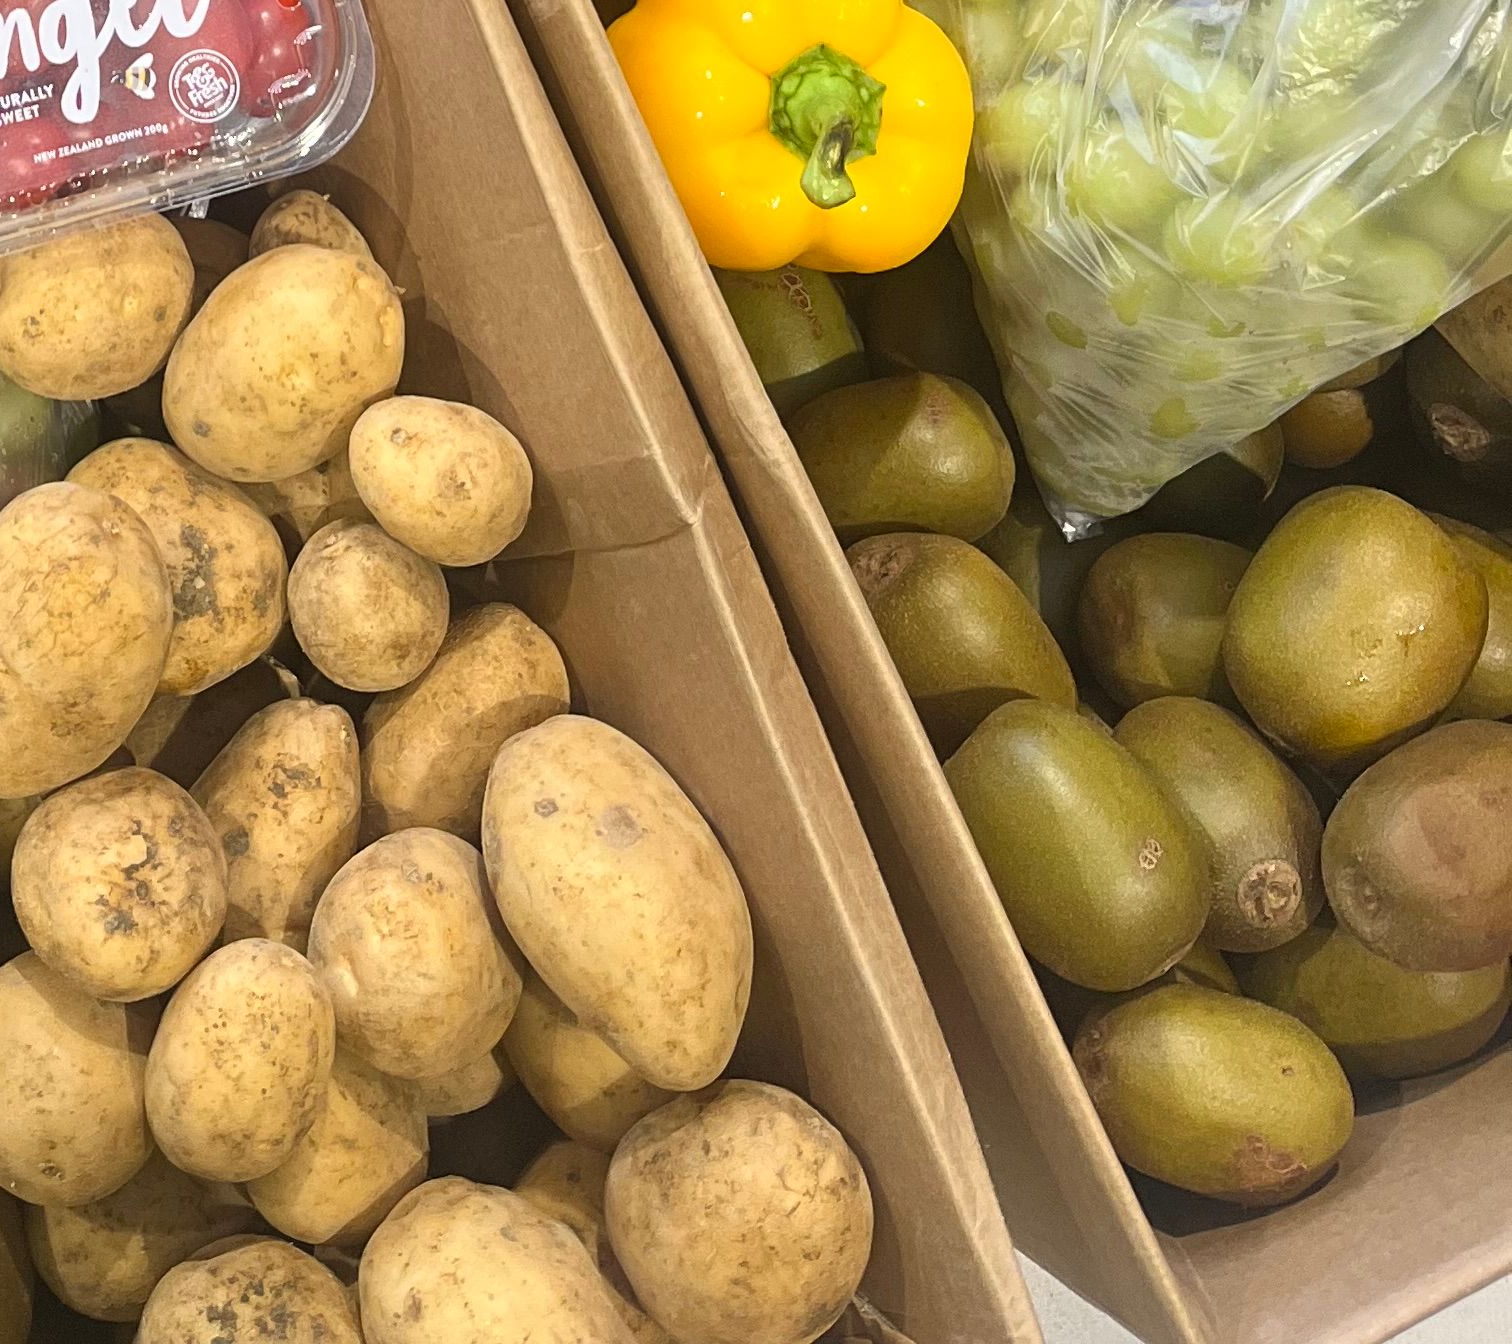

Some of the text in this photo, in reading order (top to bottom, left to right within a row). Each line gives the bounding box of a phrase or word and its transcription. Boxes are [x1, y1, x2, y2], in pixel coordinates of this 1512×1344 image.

[187, 76, 228, 107] Fresh
[32, 121, 169, 162] NEW ZEALAND GROWN 200g
